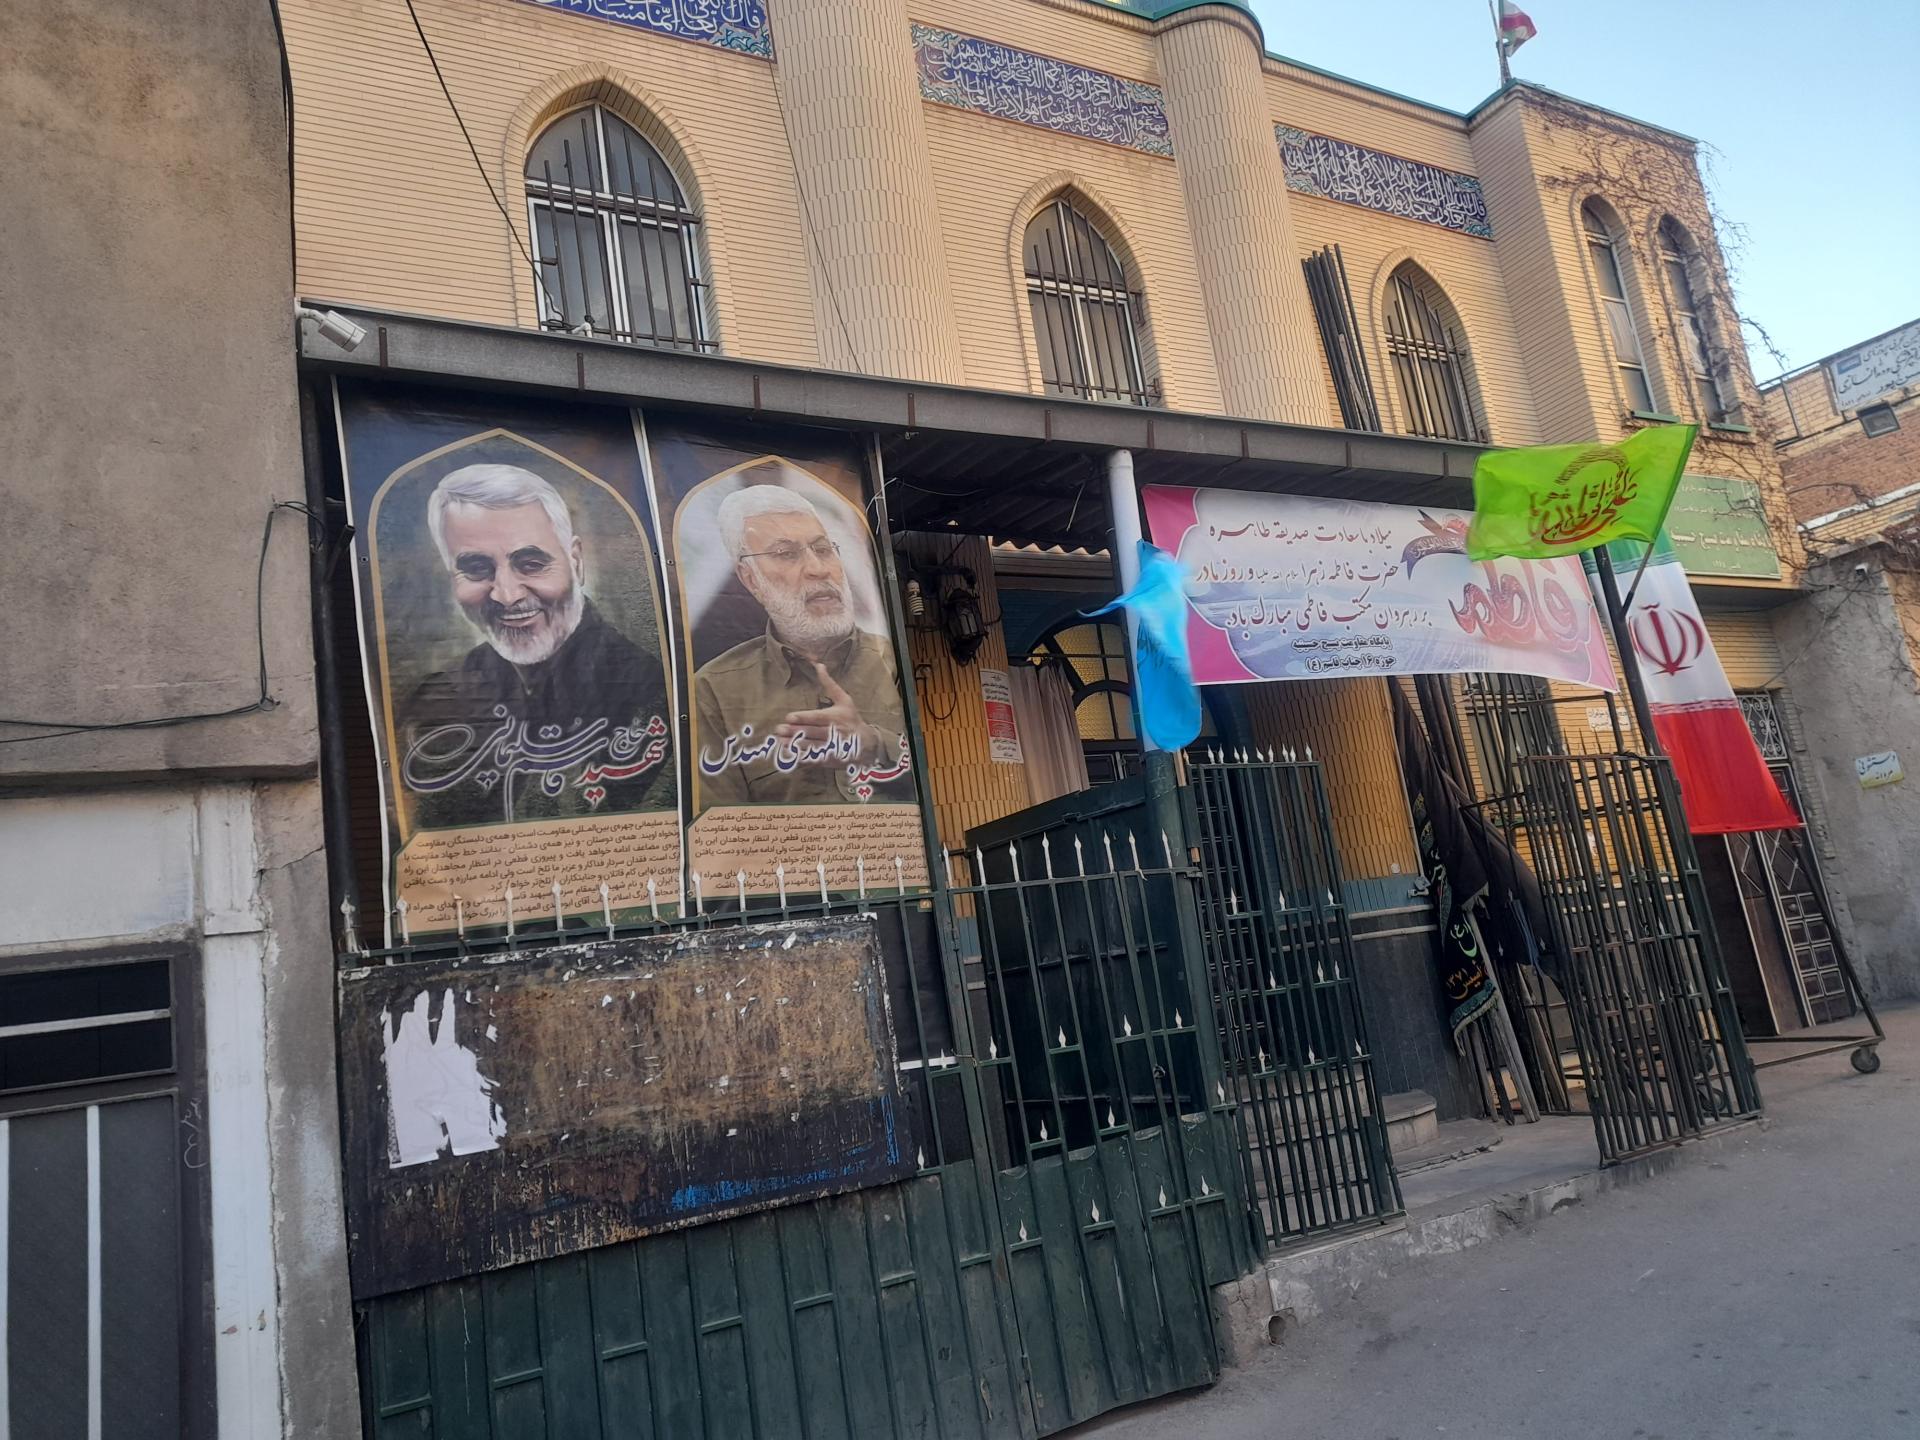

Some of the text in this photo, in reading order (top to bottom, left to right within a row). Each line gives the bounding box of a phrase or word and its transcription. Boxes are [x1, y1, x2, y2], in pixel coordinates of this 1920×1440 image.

[1209, 521, 1271, 542] طاهره
[1371, 526, 1392, 549] میلاد
[1198, 560, 1219, 581] مادر
[1222, 559, 1243, 581] روز
[1301, 560, 1325, 586] زهرا
[1328, 559, 1354, 581] فاطمه
[1358, 561, 1399, 588] حضرت
[1296, 593, 1328, 631] فاطمی
[1332, 585, 1372, 631] مکتب
[1374, 604, 1418, 630] رهروان
[1421, 610, 1433, 627] بر
[1320, 639, 1340, 652] بسیج
[1340, 635, 1369, 651] مقاومت
[1369, 635, 1393, 650] پایگاه
[1322, 656, 1341, 672] قاسم
[1340, 656, 1362, 670] جناب
[1374, 656, 1396, 670] حوزه
[701, 725, 776, 774] مهندس
[403, 704, 668, 821] شهید حاج قاسم سلیمانی
[851, 733, 910, 797] شهید
